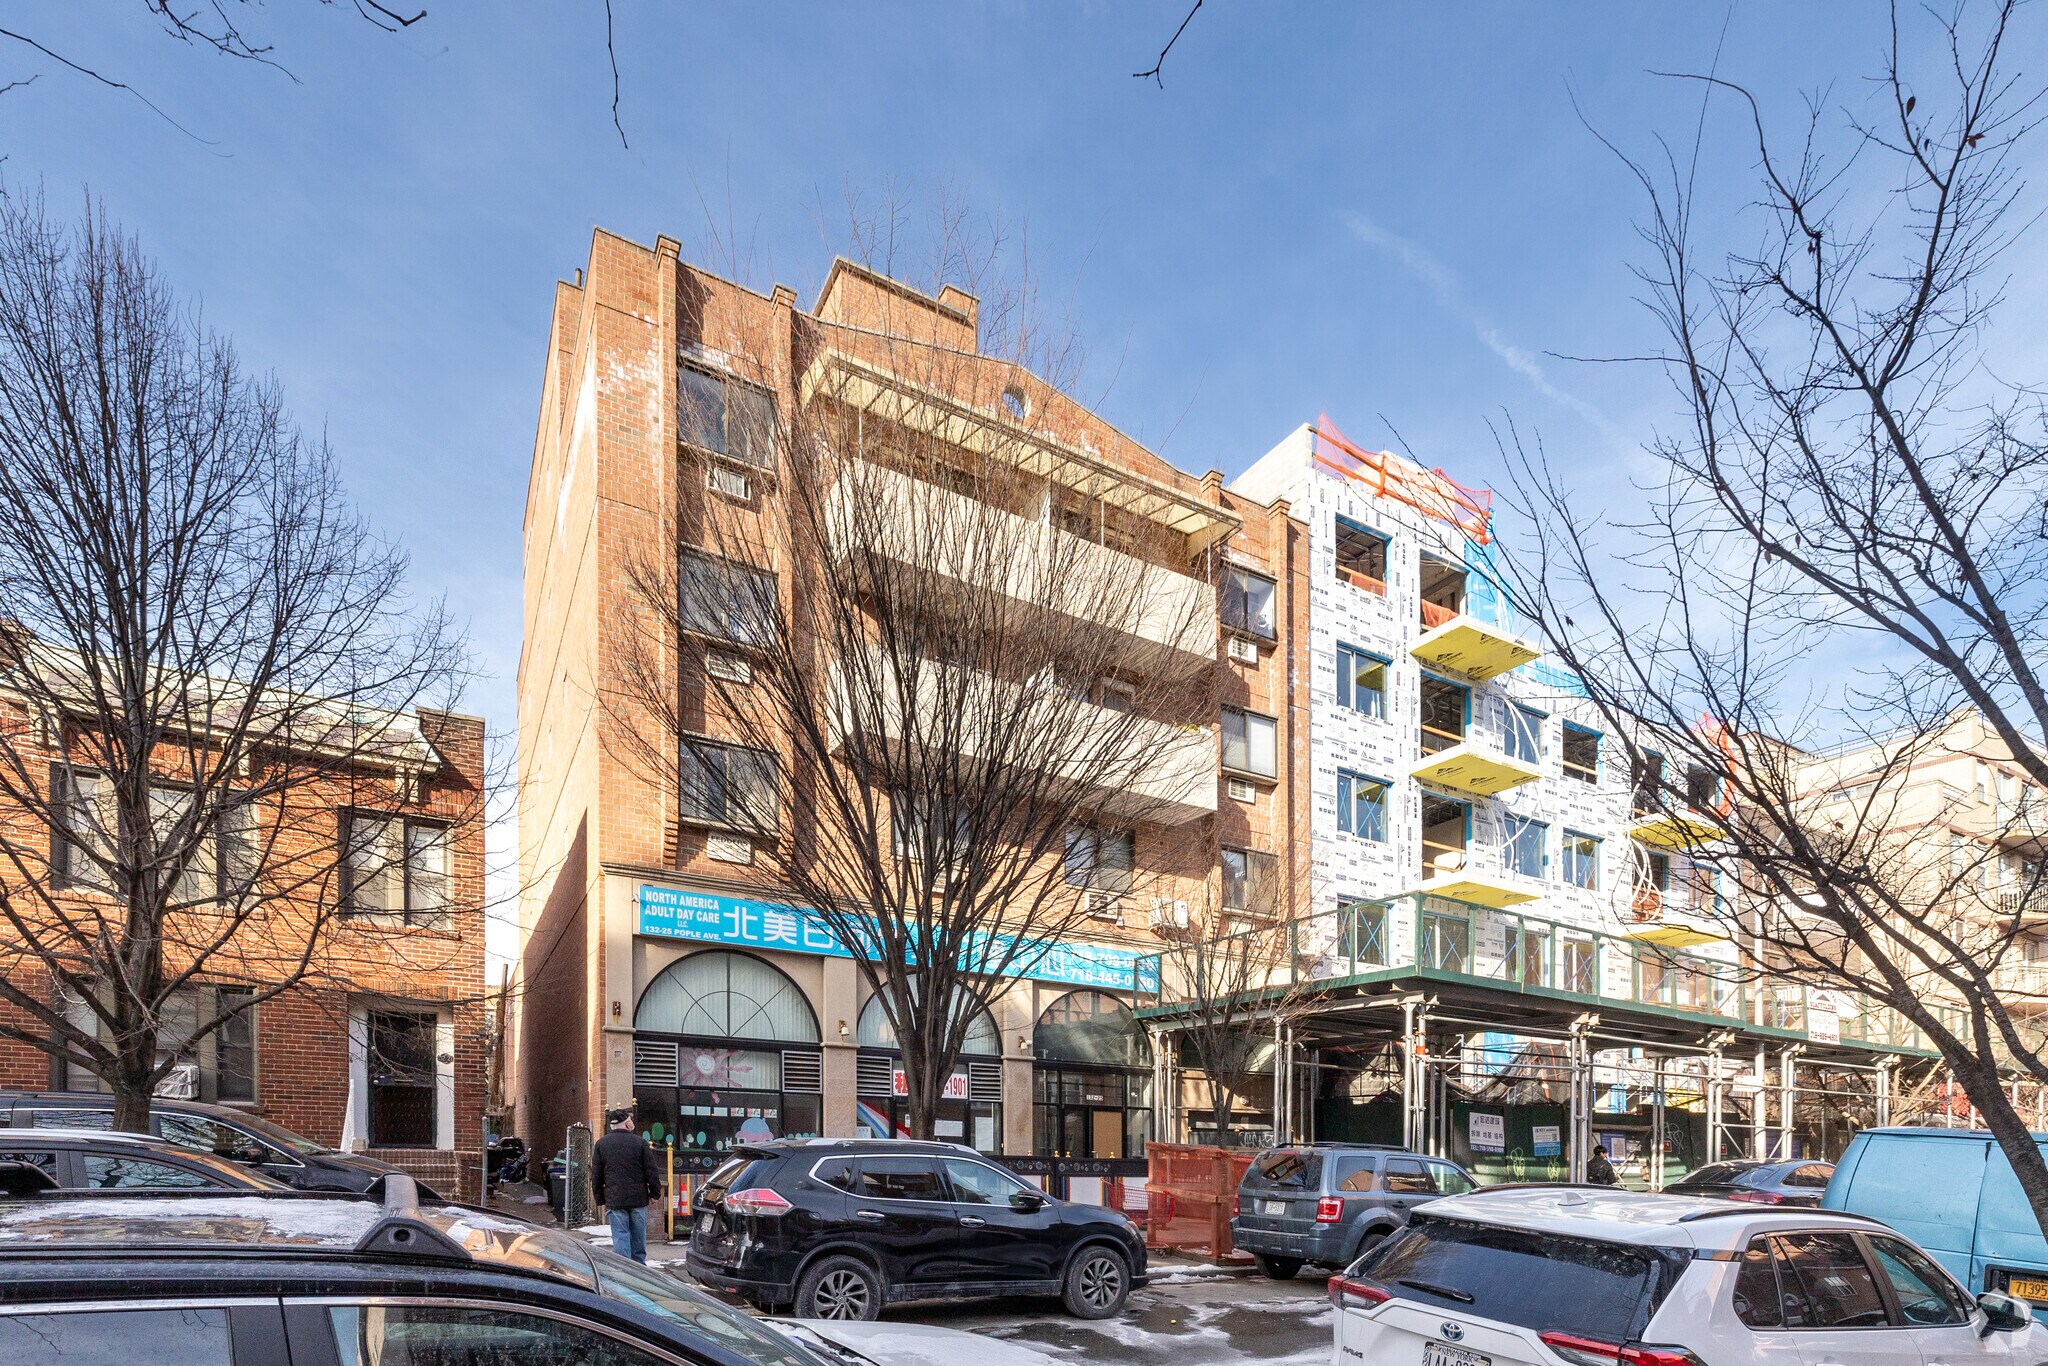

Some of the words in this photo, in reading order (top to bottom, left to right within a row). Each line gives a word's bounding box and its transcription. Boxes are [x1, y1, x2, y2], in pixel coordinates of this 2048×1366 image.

[645, 890, 677, 905] NORTH
[679, 895, 719, 910] AMERICA
[645, 904, 675, 918] ADULT
[677, 908, 695, 920] DAY
[696, 911, 720, 924] CARE
[645, 925, 672, 934] 132-25
[674, 928, 701, 938] POPLE
[702, 932, 722, 940] AVE.
[677, 920, 689, 928] LLC.
